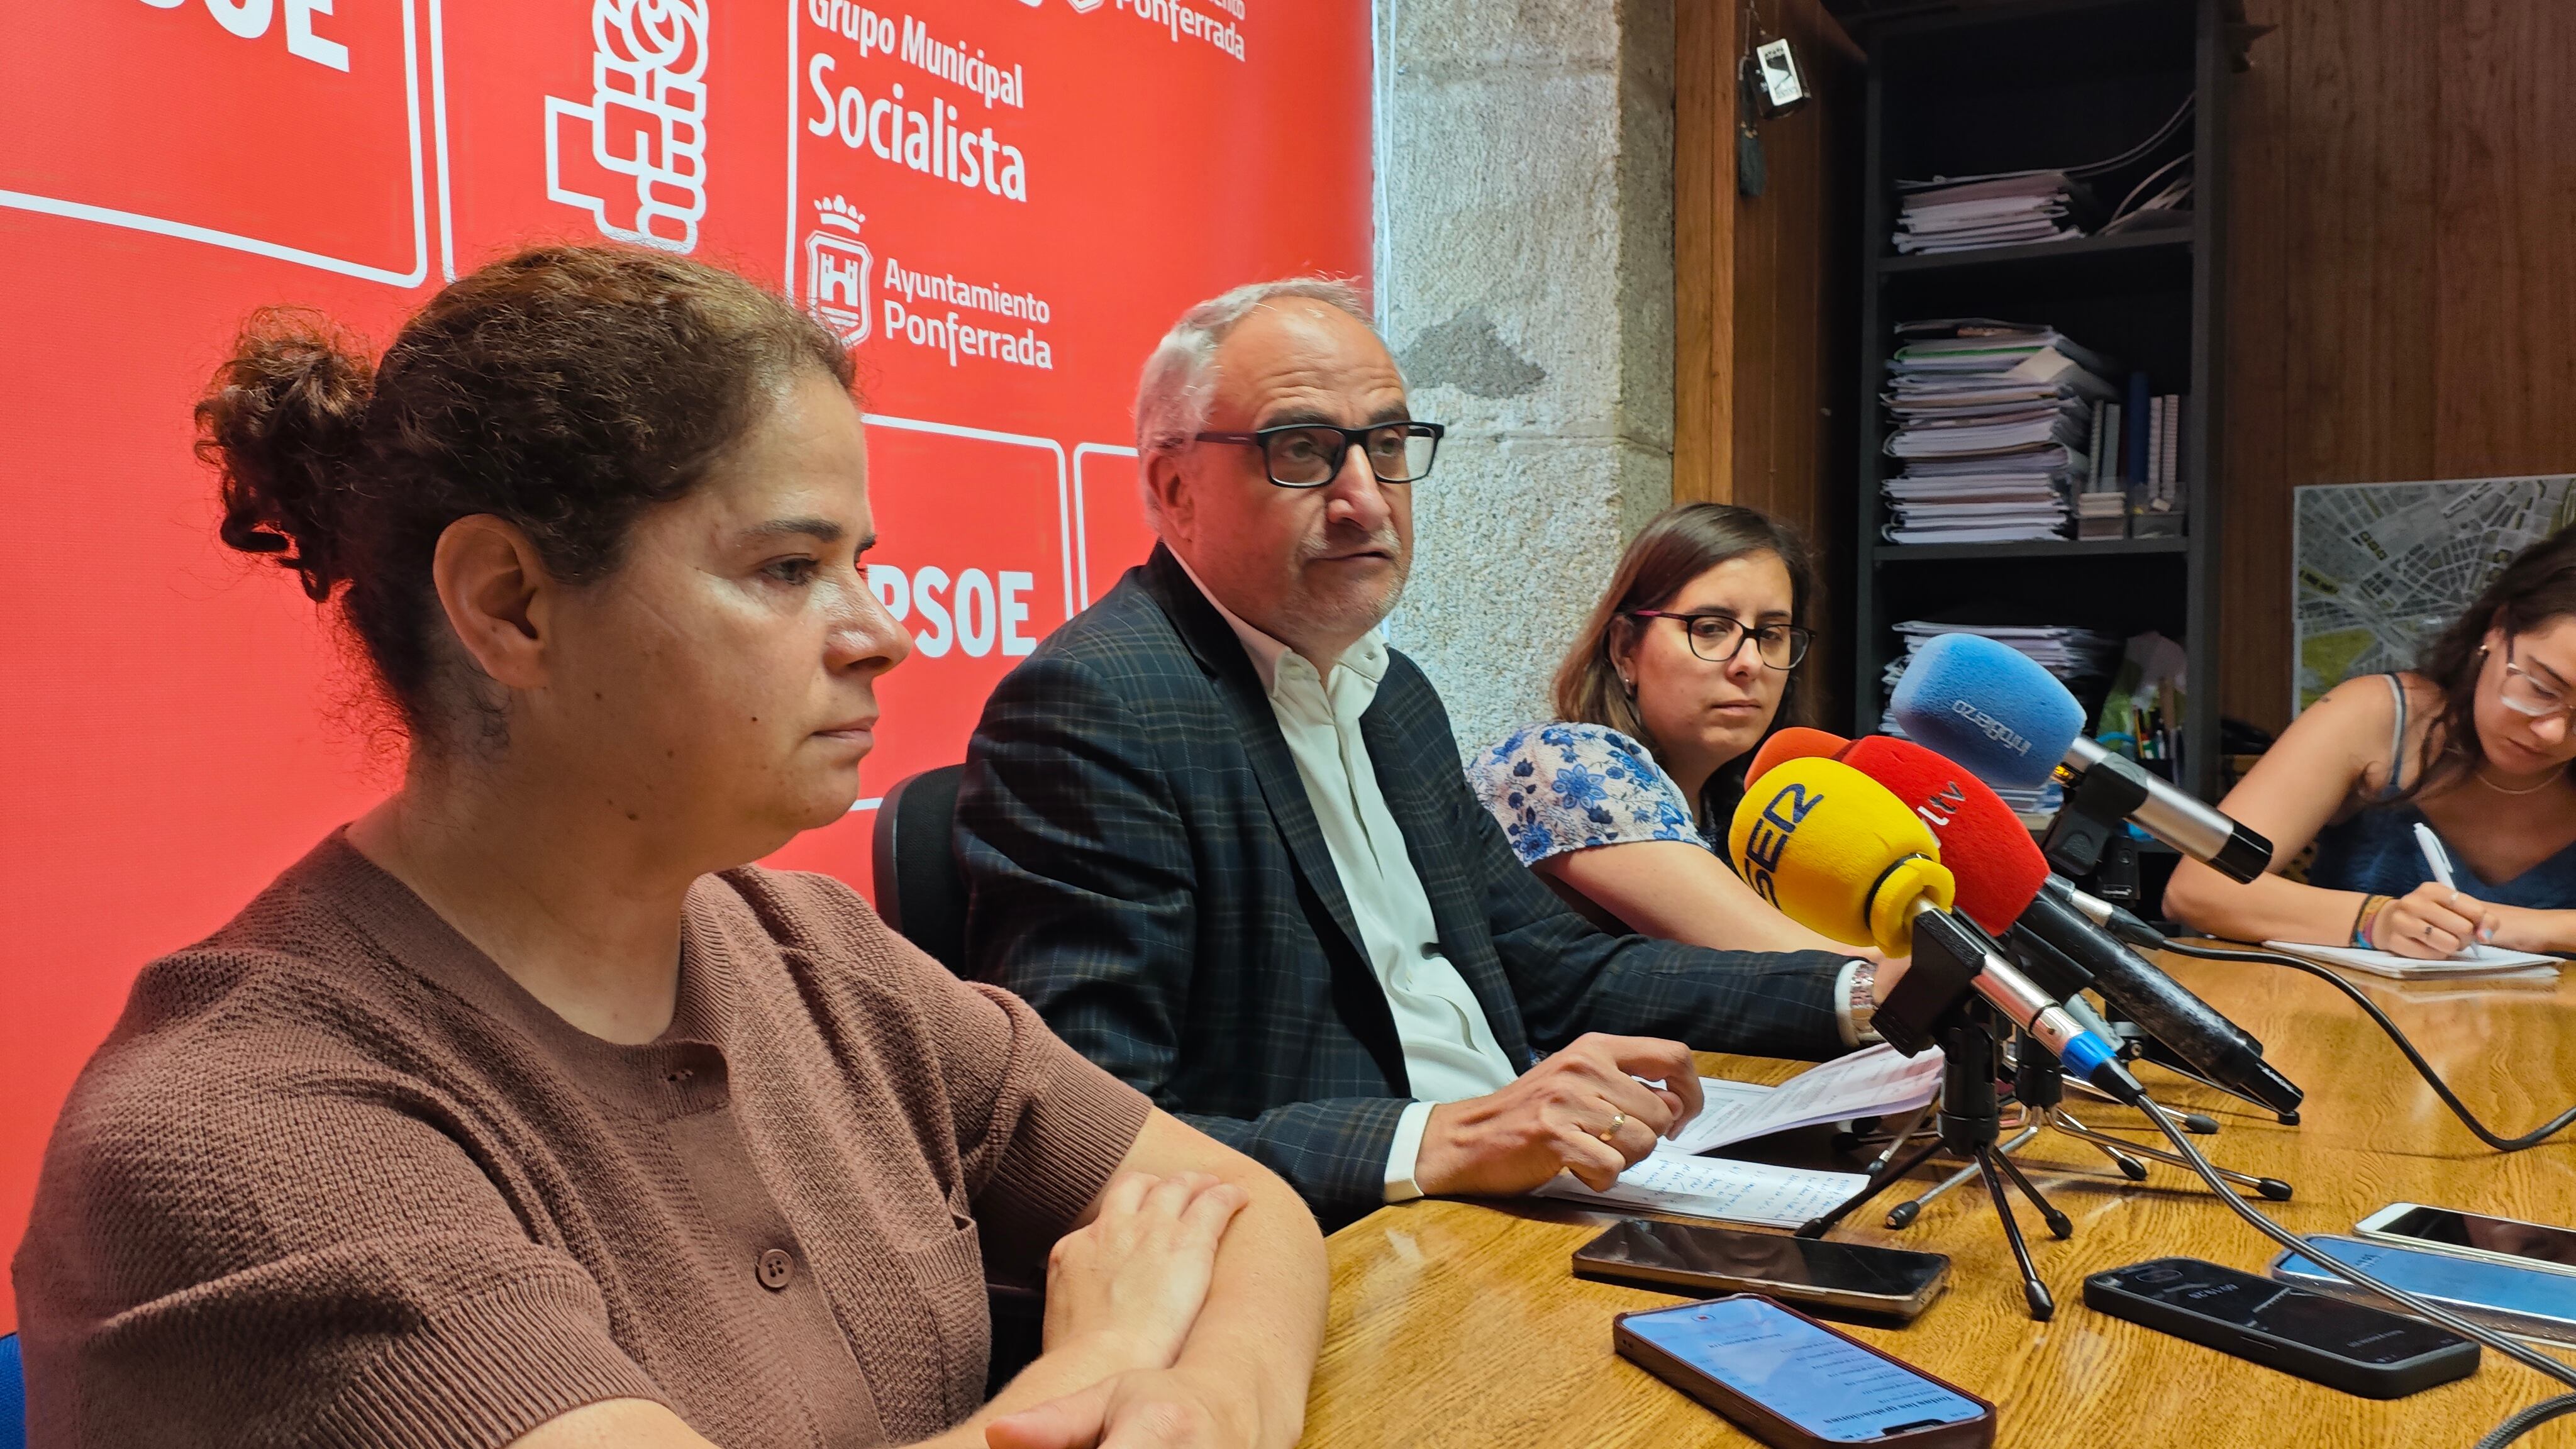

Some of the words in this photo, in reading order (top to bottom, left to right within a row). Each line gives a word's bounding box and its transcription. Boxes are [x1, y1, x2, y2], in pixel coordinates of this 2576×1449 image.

[808, 0, 895, 58] Grupo
[901, 14, 1023, 109] Municipal
[1114, 0, 1245, 62] onferrada
[808, 53, 1027, 202] Socialista
[883, 299, 1053, 369] Ponferrada
[884, 257, 1050, 324] Ayuntamiento
[867, 564, 1037, 657] PSOE
[1744, 783, 1824, 911] SER
